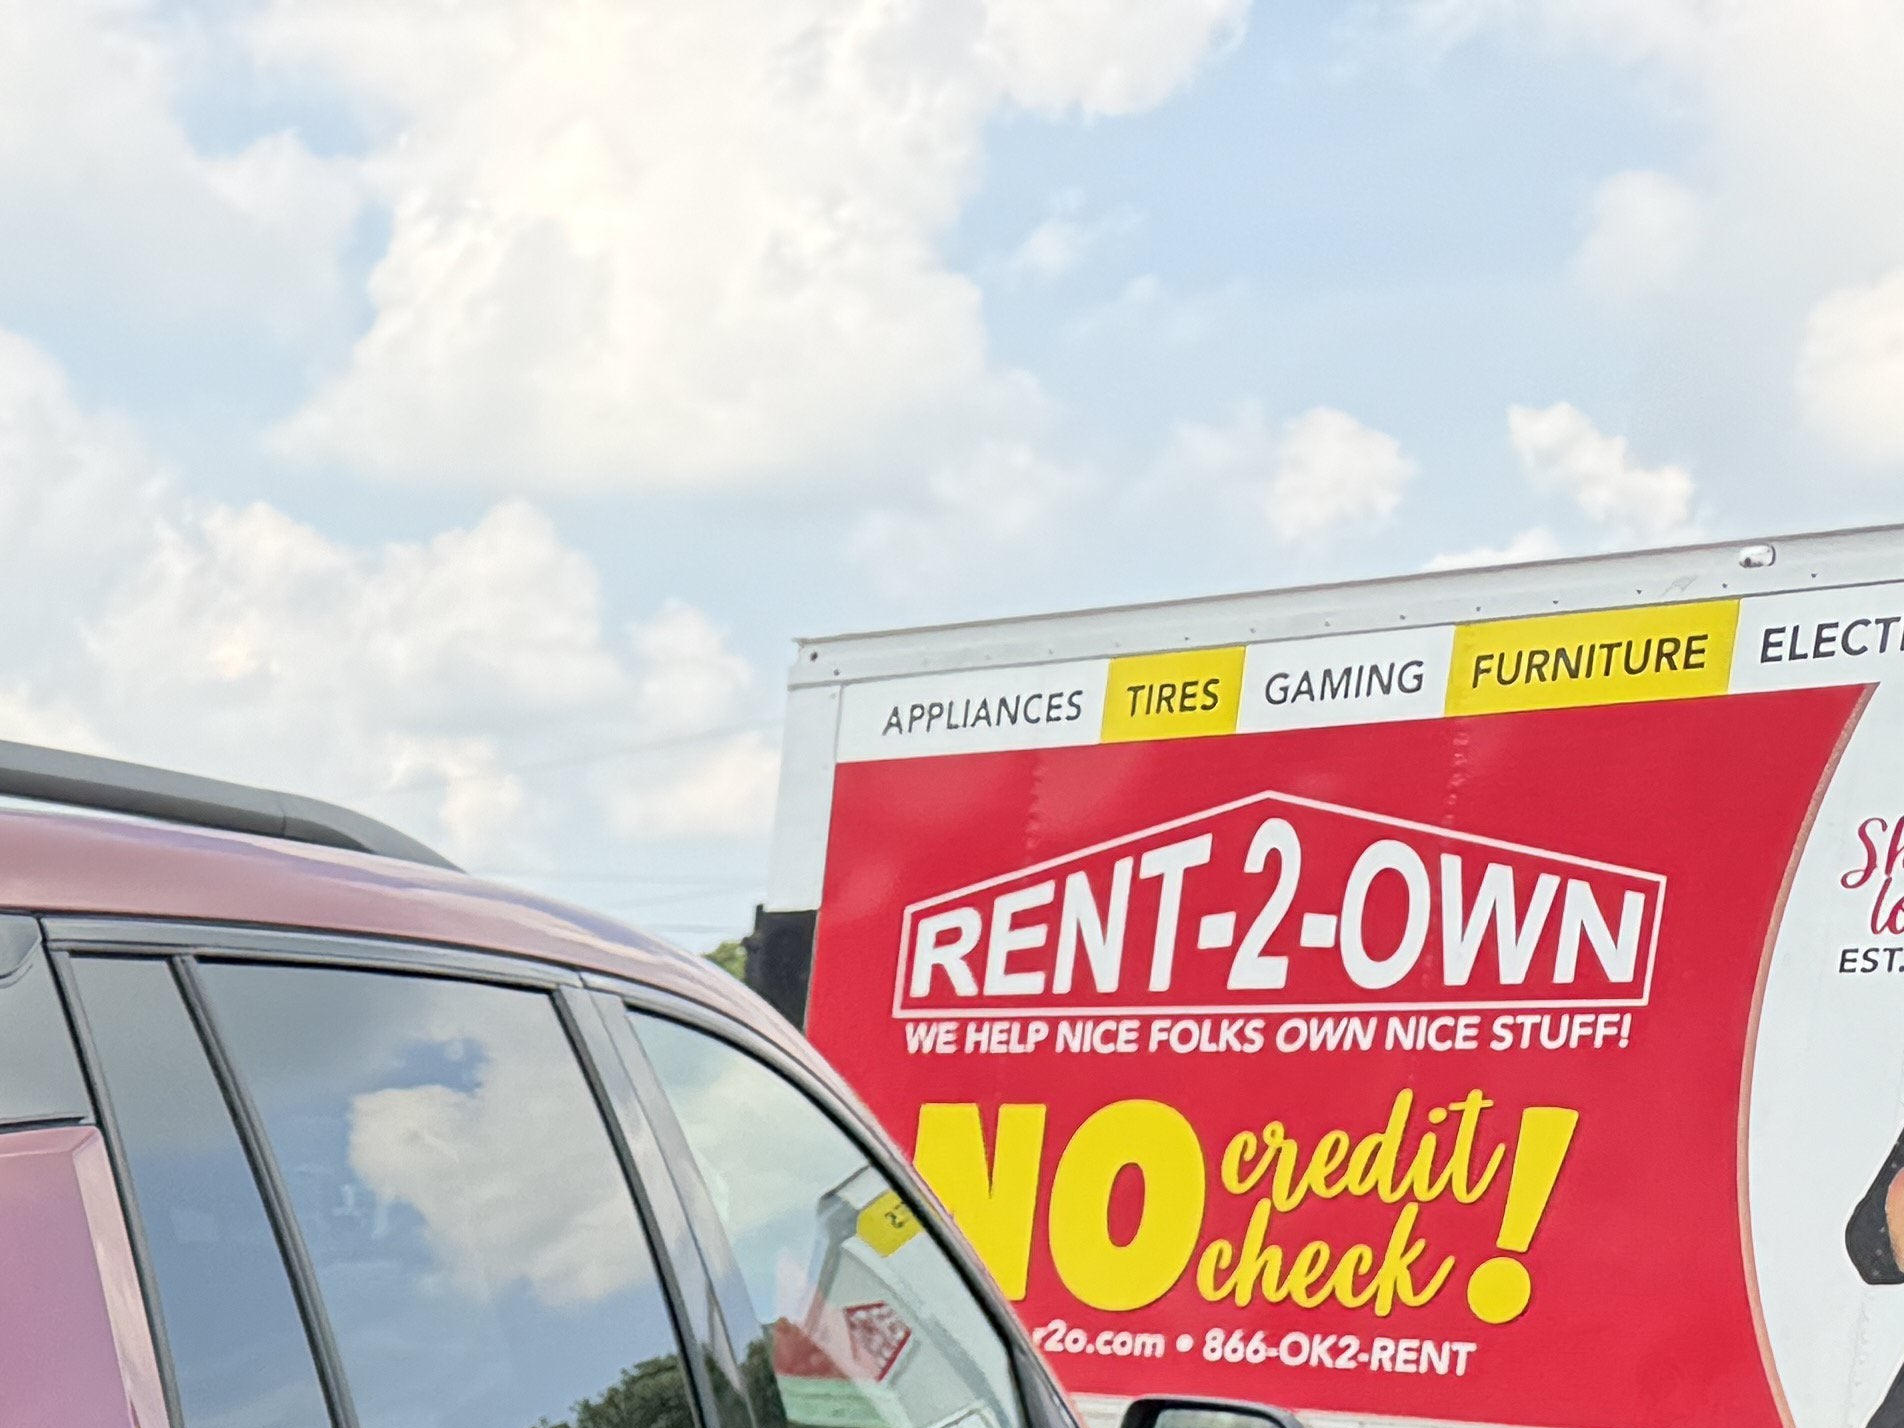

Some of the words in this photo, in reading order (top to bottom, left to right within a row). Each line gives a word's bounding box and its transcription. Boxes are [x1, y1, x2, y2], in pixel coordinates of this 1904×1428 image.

[1472, 633, 1710, 690] FURNITURE
[1760, 616, 1904, 664] ELECT
[1127, 677, 1221, 719] TIRES
[1264, 659, 1426, 707] GAMING
[882, 689, 1085, 737] APPLIANCES
[908, 817, 1647, 998] RENT-2-OWN
[904, 1020, 958, 1055] WE
[964, 1020, 1048, 1054] HELP
[1055, 1018, 1140, 1053] NICE
[1147, 1017, 1265, 1053] FOLKS
[1275, 1016, 1375, 1052] OWN
[1384, 1014, 1479, 1051] NICE
[1488, 1012, 1632, 1051] STUFF!
[1220, 1087, 1506, 1213] credit
[912, 1098, 1206, 1312] NO
[1202, 1327, 1478, 1377] 866-OK2-RENT
